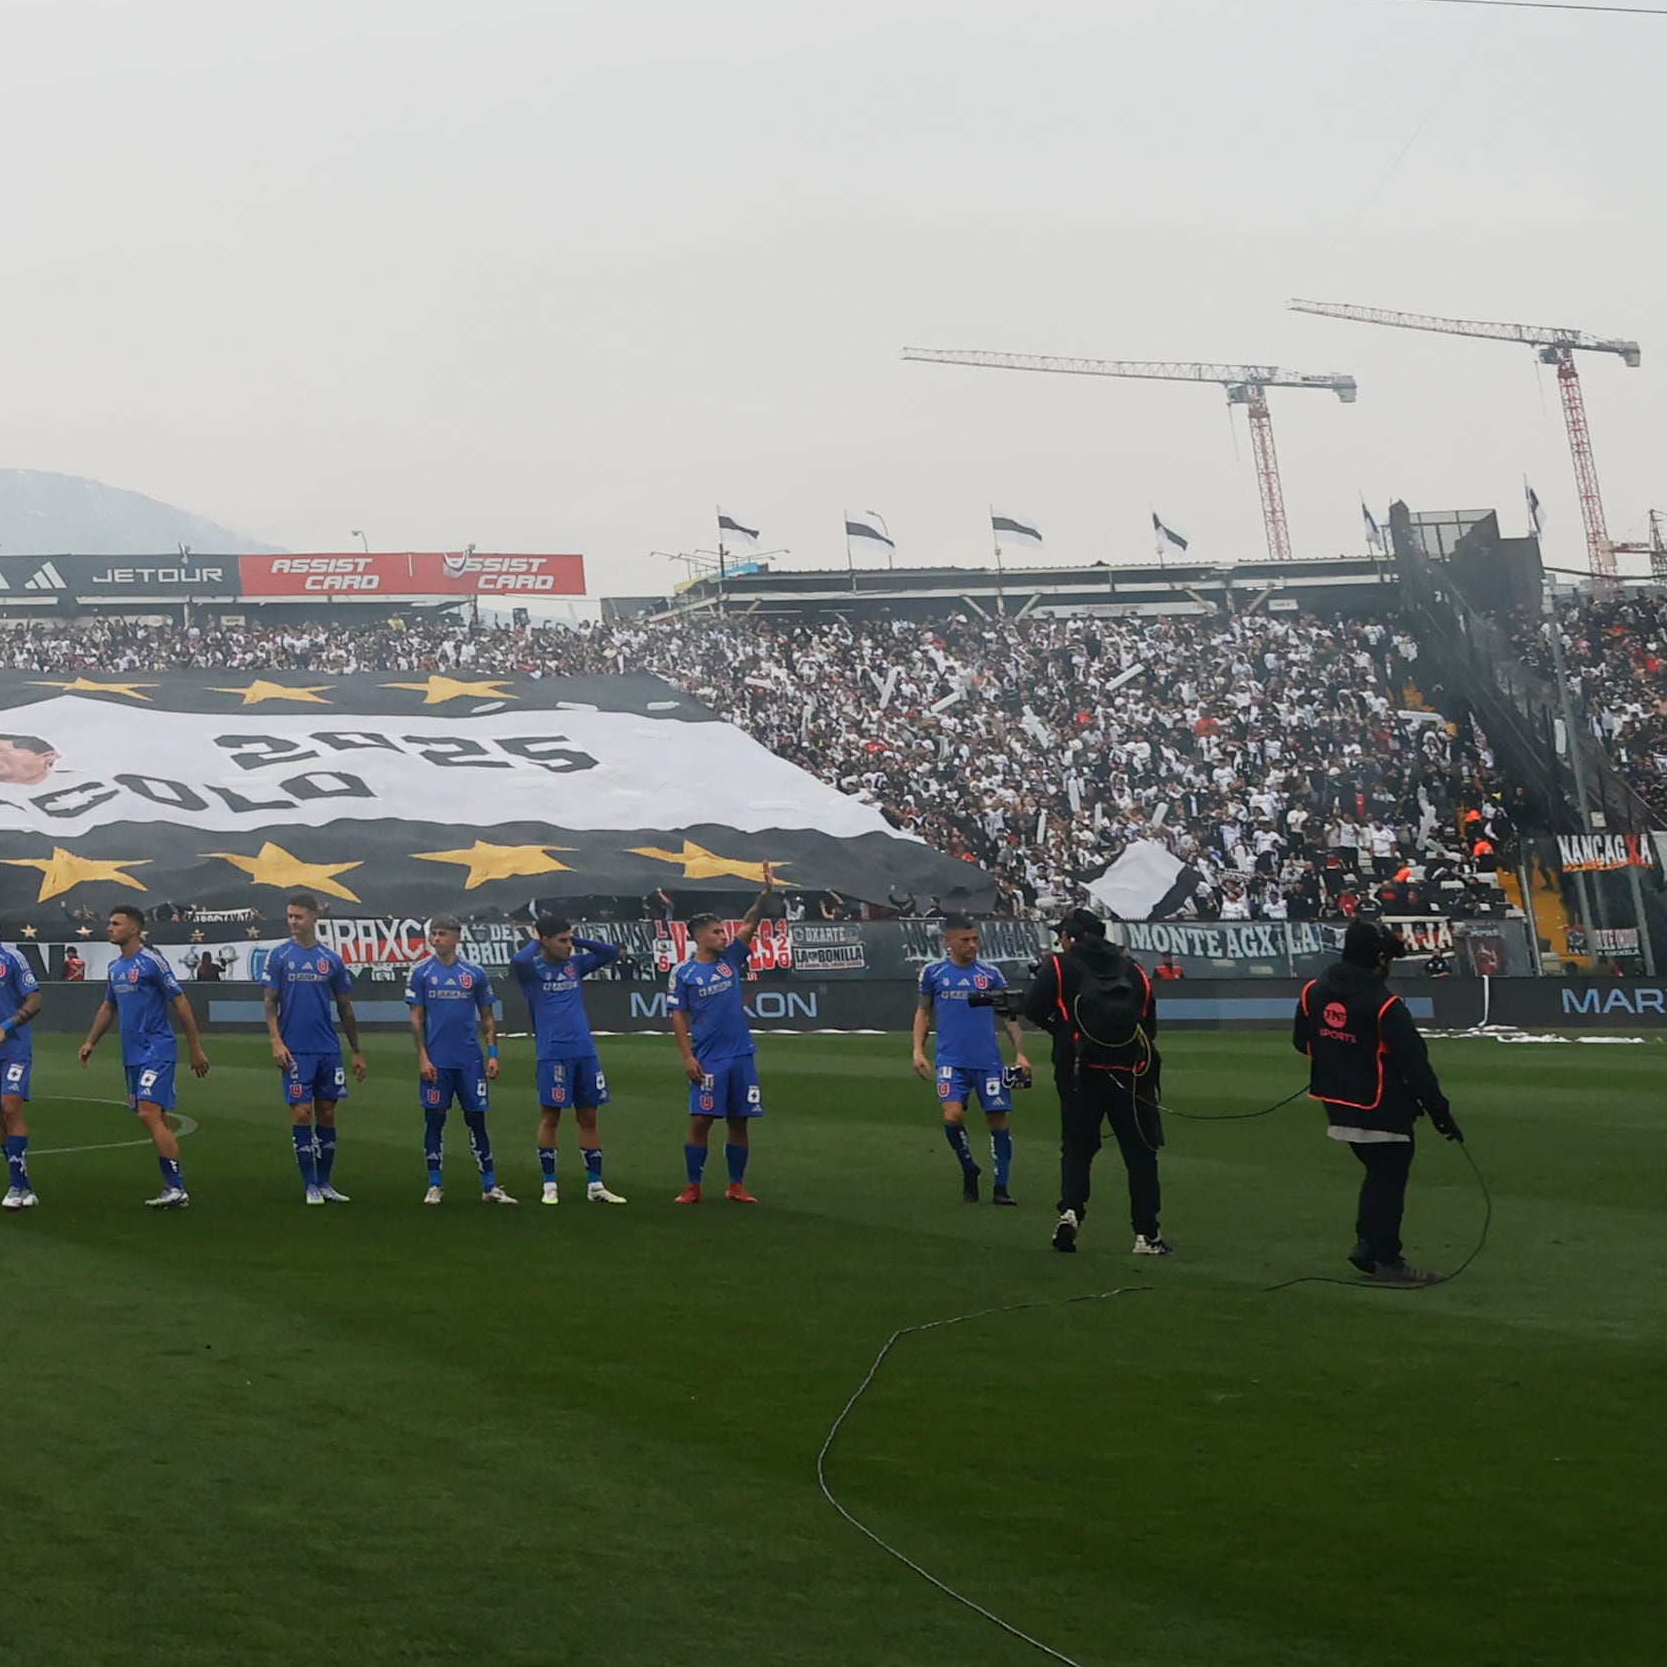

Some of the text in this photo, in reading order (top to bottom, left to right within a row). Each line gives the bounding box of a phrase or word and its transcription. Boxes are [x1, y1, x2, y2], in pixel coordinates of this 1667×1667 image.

[92, 567, 224, 583] JETOUR
[271, 558, 373, 574] ASSIST
[304, 574, 381, 591] CARD
[477, 574, 555, 591] CARD
[213, 731, 600, 773] 2025
[314, 917, 433, 964] ARAXC
[1126, 923, 1223, 958] MONTE
[1397, 921, 1455, 952] AJA
[818, 947, 863, 963] BONILLA
[1561, 988, 1667, 1014] MAR
